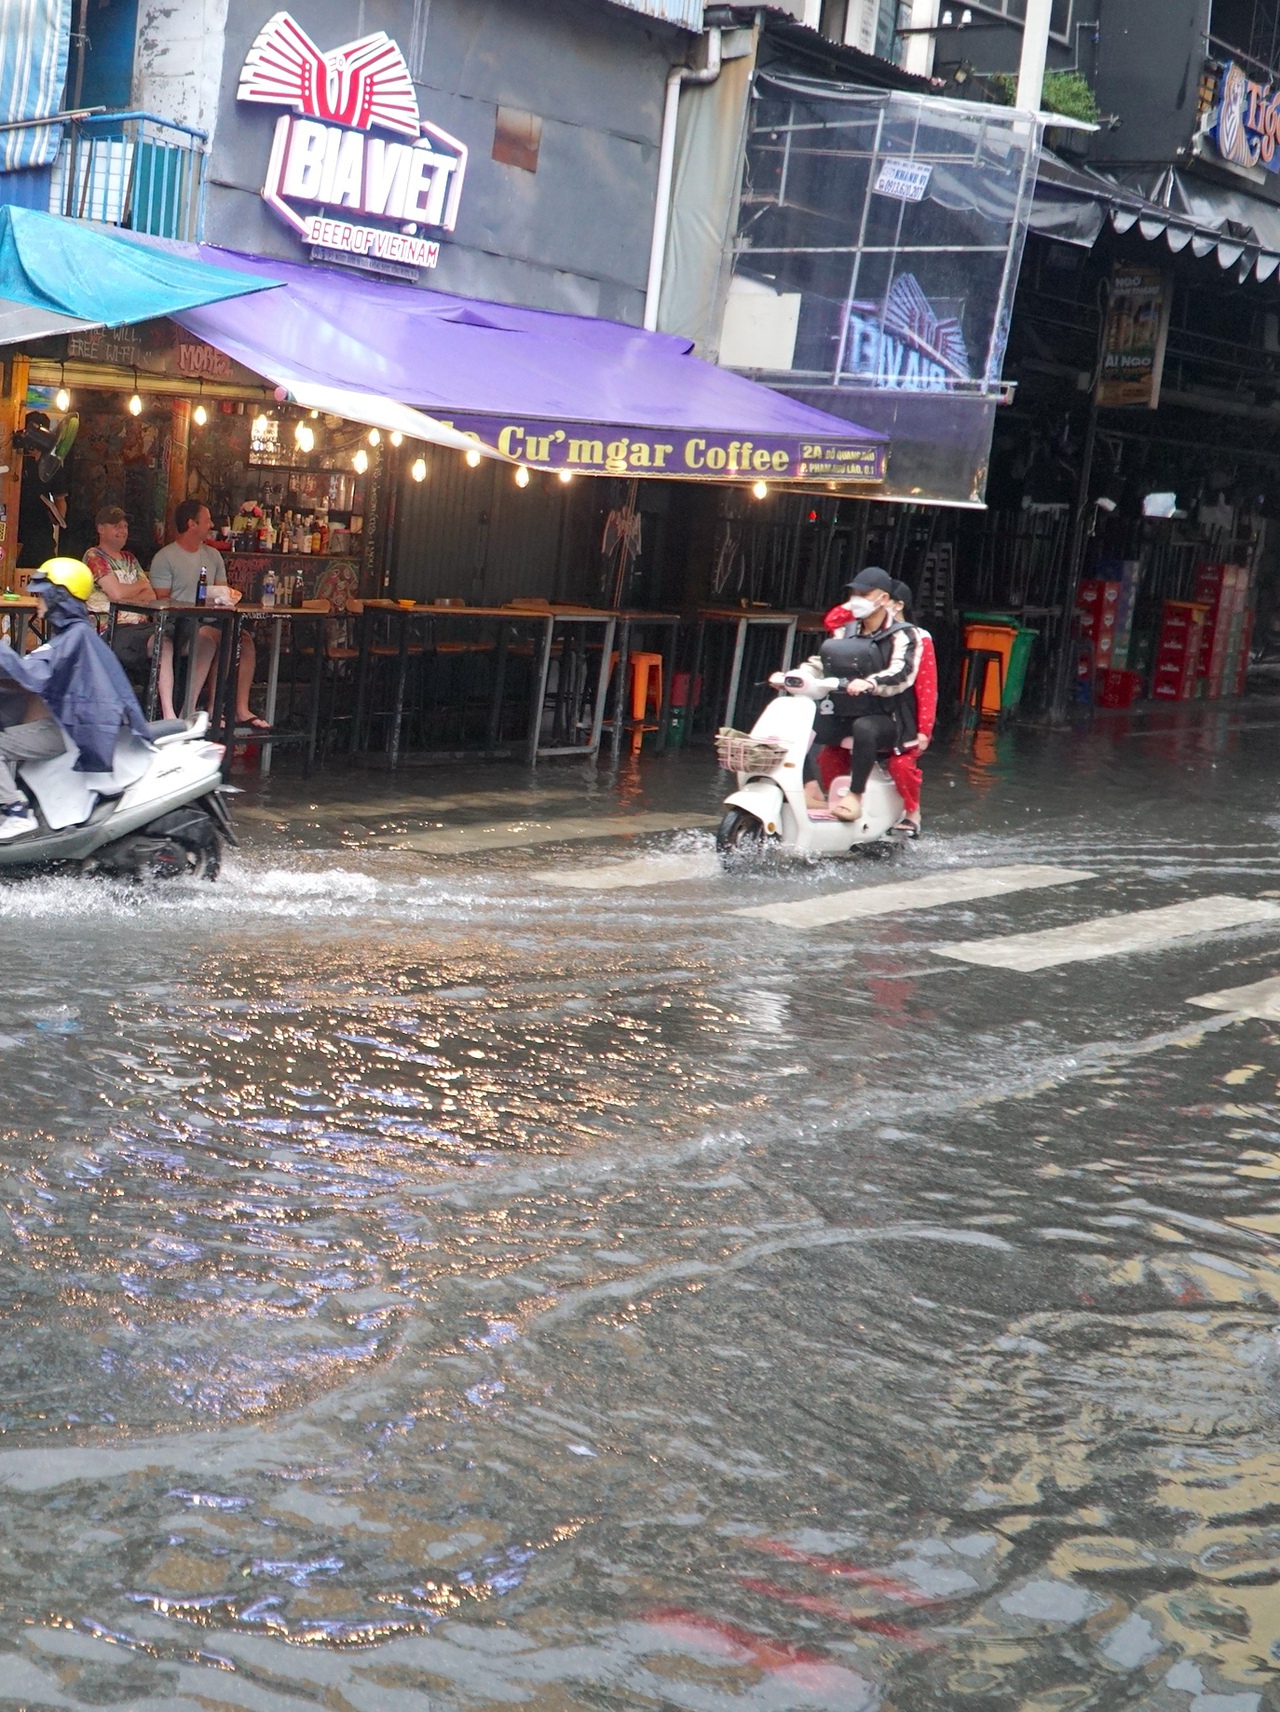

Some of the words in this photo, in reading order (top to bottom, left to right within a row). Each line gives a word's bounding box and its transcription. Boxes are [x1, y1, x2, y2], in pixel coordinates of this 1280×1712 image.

[1246, 80, 1280, 163] Tig
[283, 119, 365, 209] BIA
[365, 137, 458, 235] VIỆT
[308, 217, 352, 250] BEER
[352, 225, 375, 255] OF
[375, 229, 440, 268] VIETNAM
[71, 338, 98, 359] FREE
[684, 438, 790, 472] Coffee
[803, 445, 822, 459] 2A
